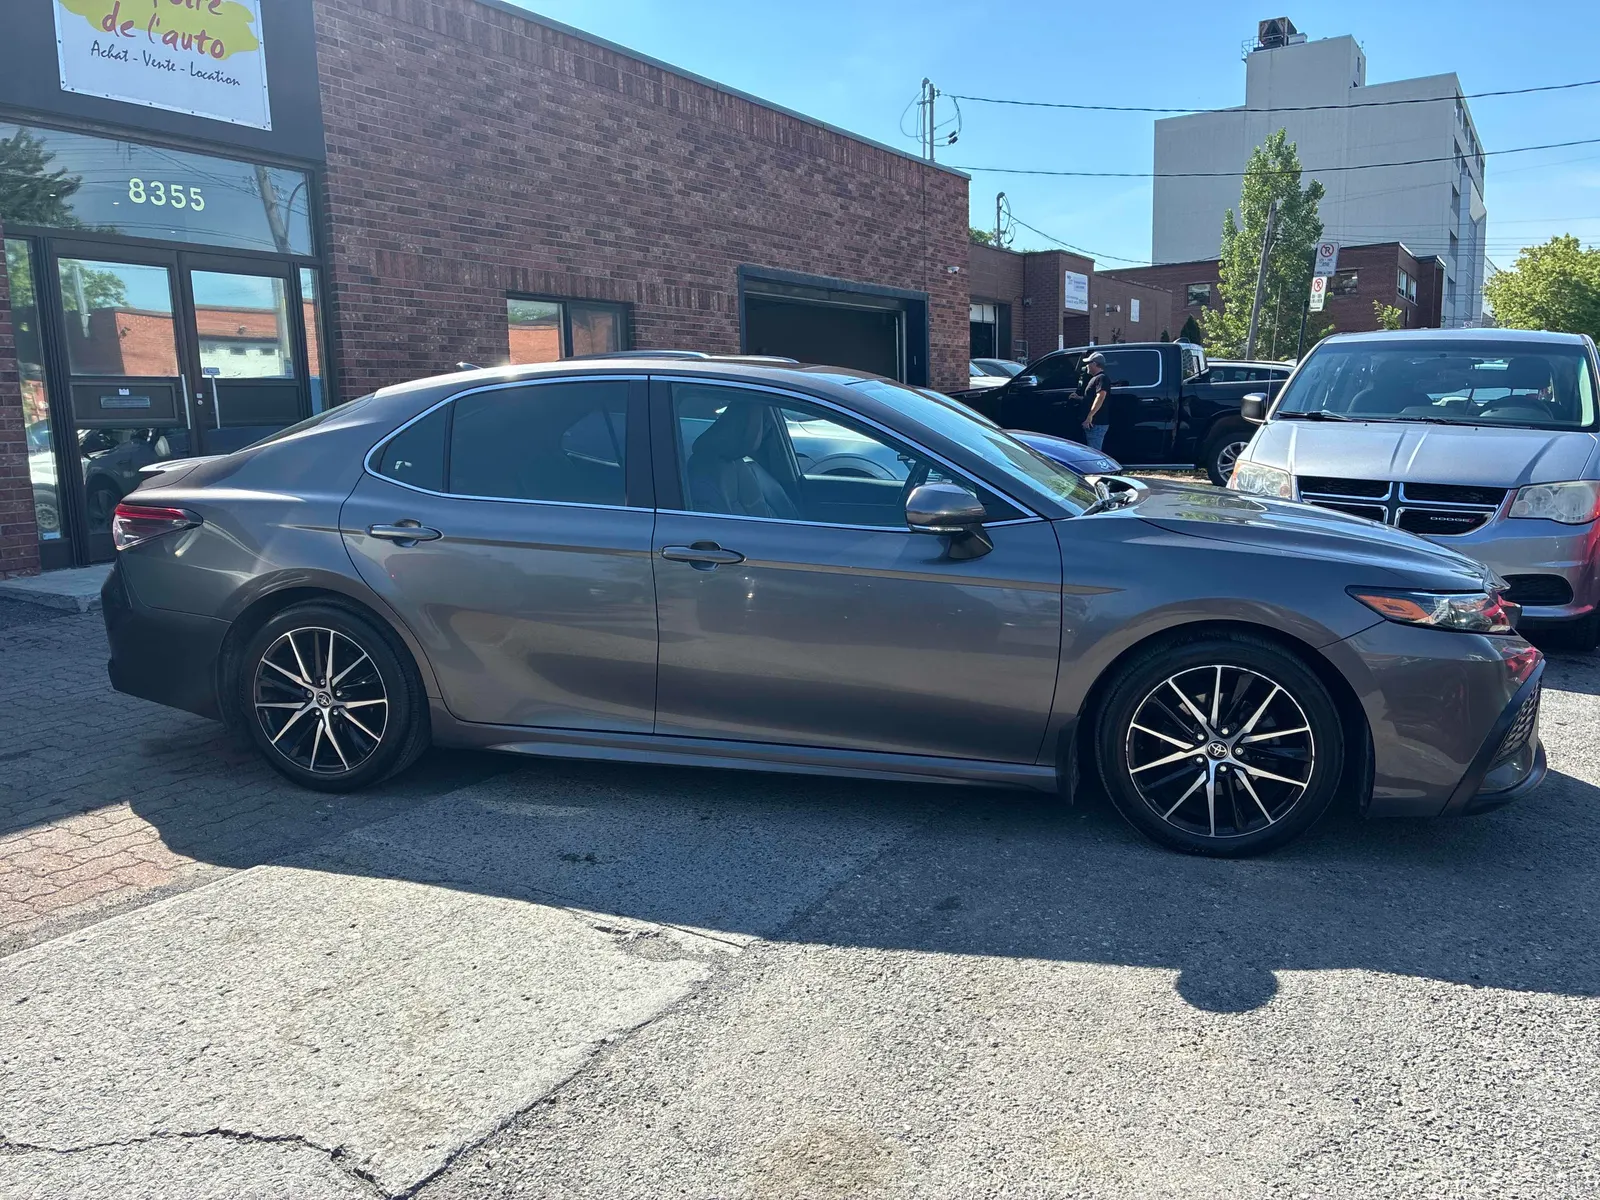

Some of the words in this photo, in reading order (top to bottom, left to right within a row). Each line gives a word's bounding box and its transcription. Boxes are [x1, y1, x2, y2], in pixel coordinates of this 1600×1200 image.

[102, 1, 136, 37] de
[148, 12, 225, 58] l'auto
[91, 40, 128, 62] Achat
[143, 50, 176, 71] Vente
[190, 61, 240, 86] Location
[128, 177, 205, 211] 8355
